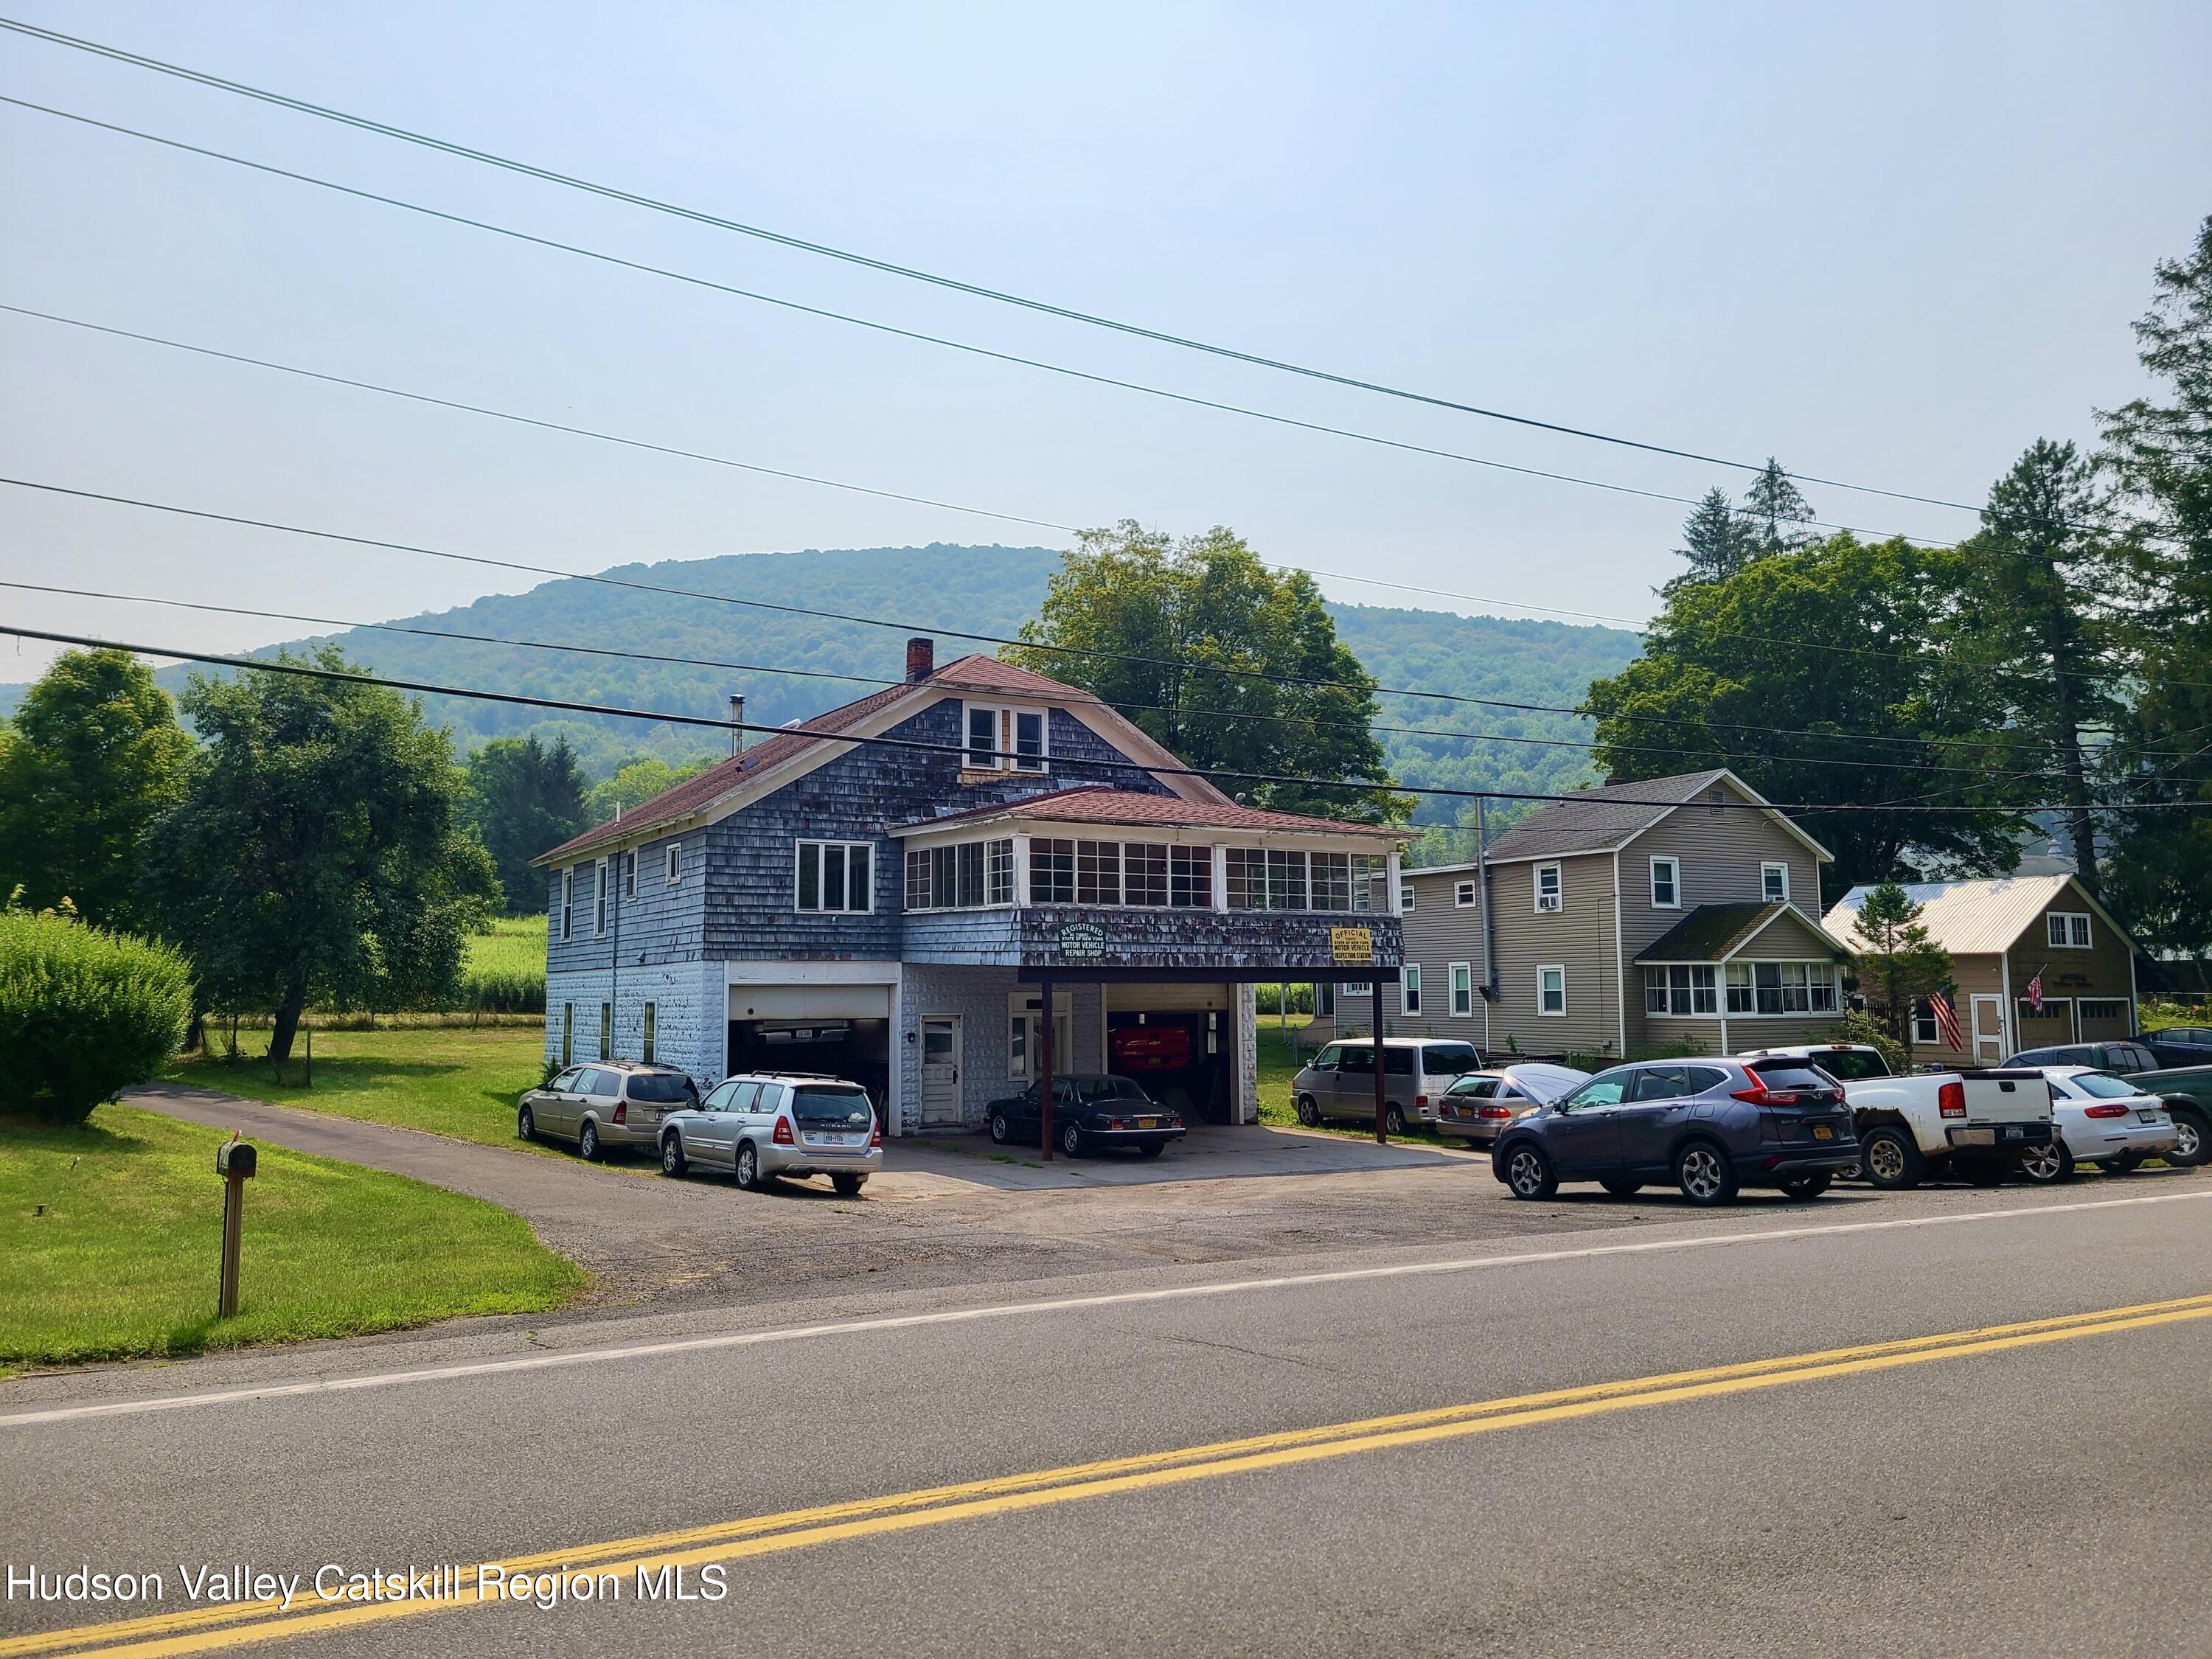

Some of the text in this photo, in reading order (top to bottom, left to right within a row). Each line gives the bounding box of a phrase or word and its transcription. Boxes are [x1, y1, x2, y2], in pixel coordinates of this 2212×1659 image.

[1061, 923, 1104, 936] REGISTERED
[1335, 930, 1368, 939] OFFICIAL
[1062, 941, 1105, 949] MOTOR VEHICLE
